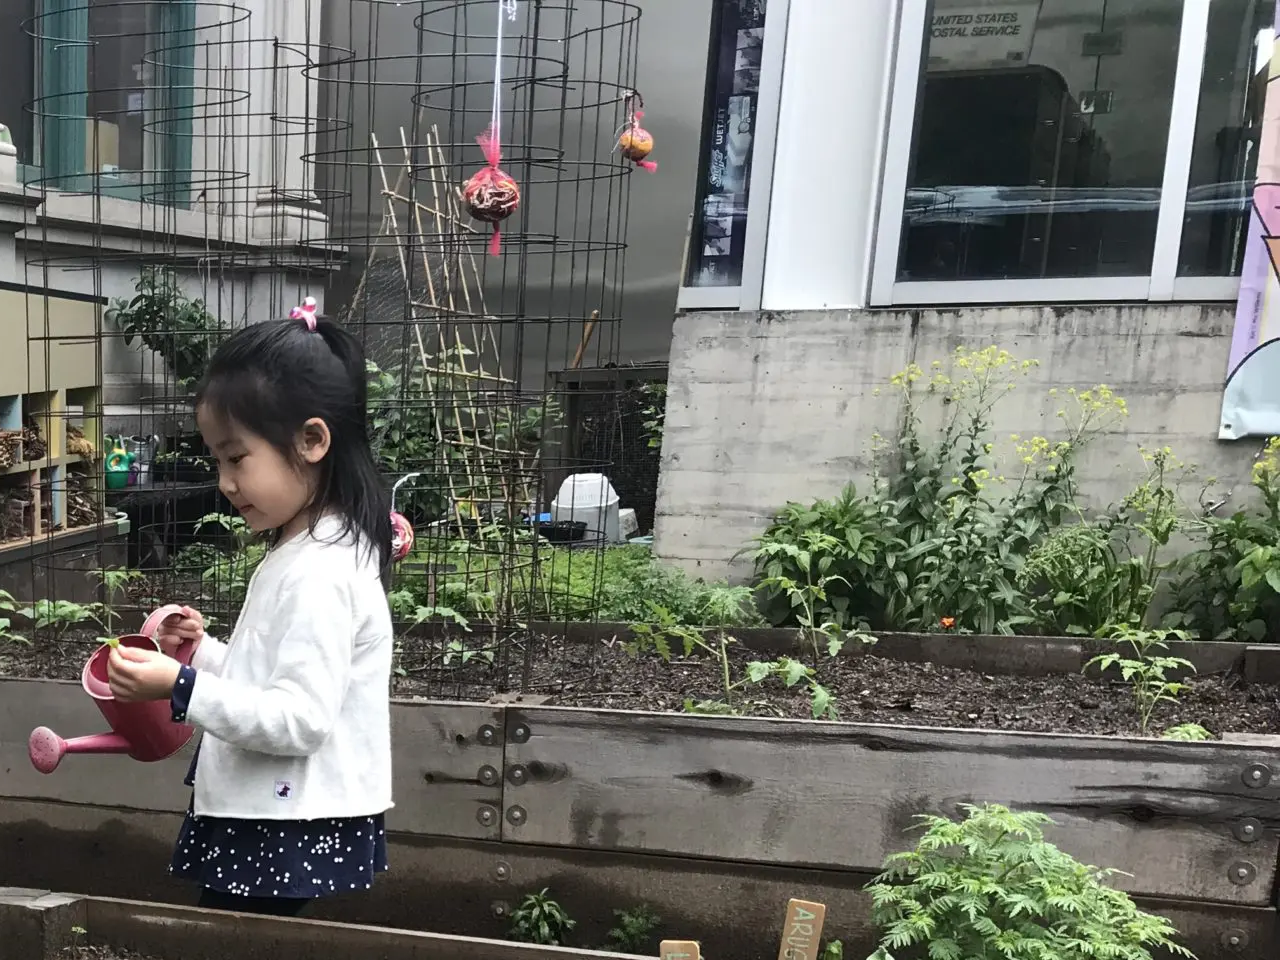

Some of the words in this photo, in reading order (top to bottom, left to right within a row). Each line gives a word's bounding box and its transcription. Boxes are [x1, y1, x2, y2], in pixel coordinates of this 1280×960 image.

[932, 15, 973, 25] UNITED
[975, 13, 1018, 24] STATES
[931, 26, 968, 37] OSTAL
[970, 25, 1021, 37] SERVICE
